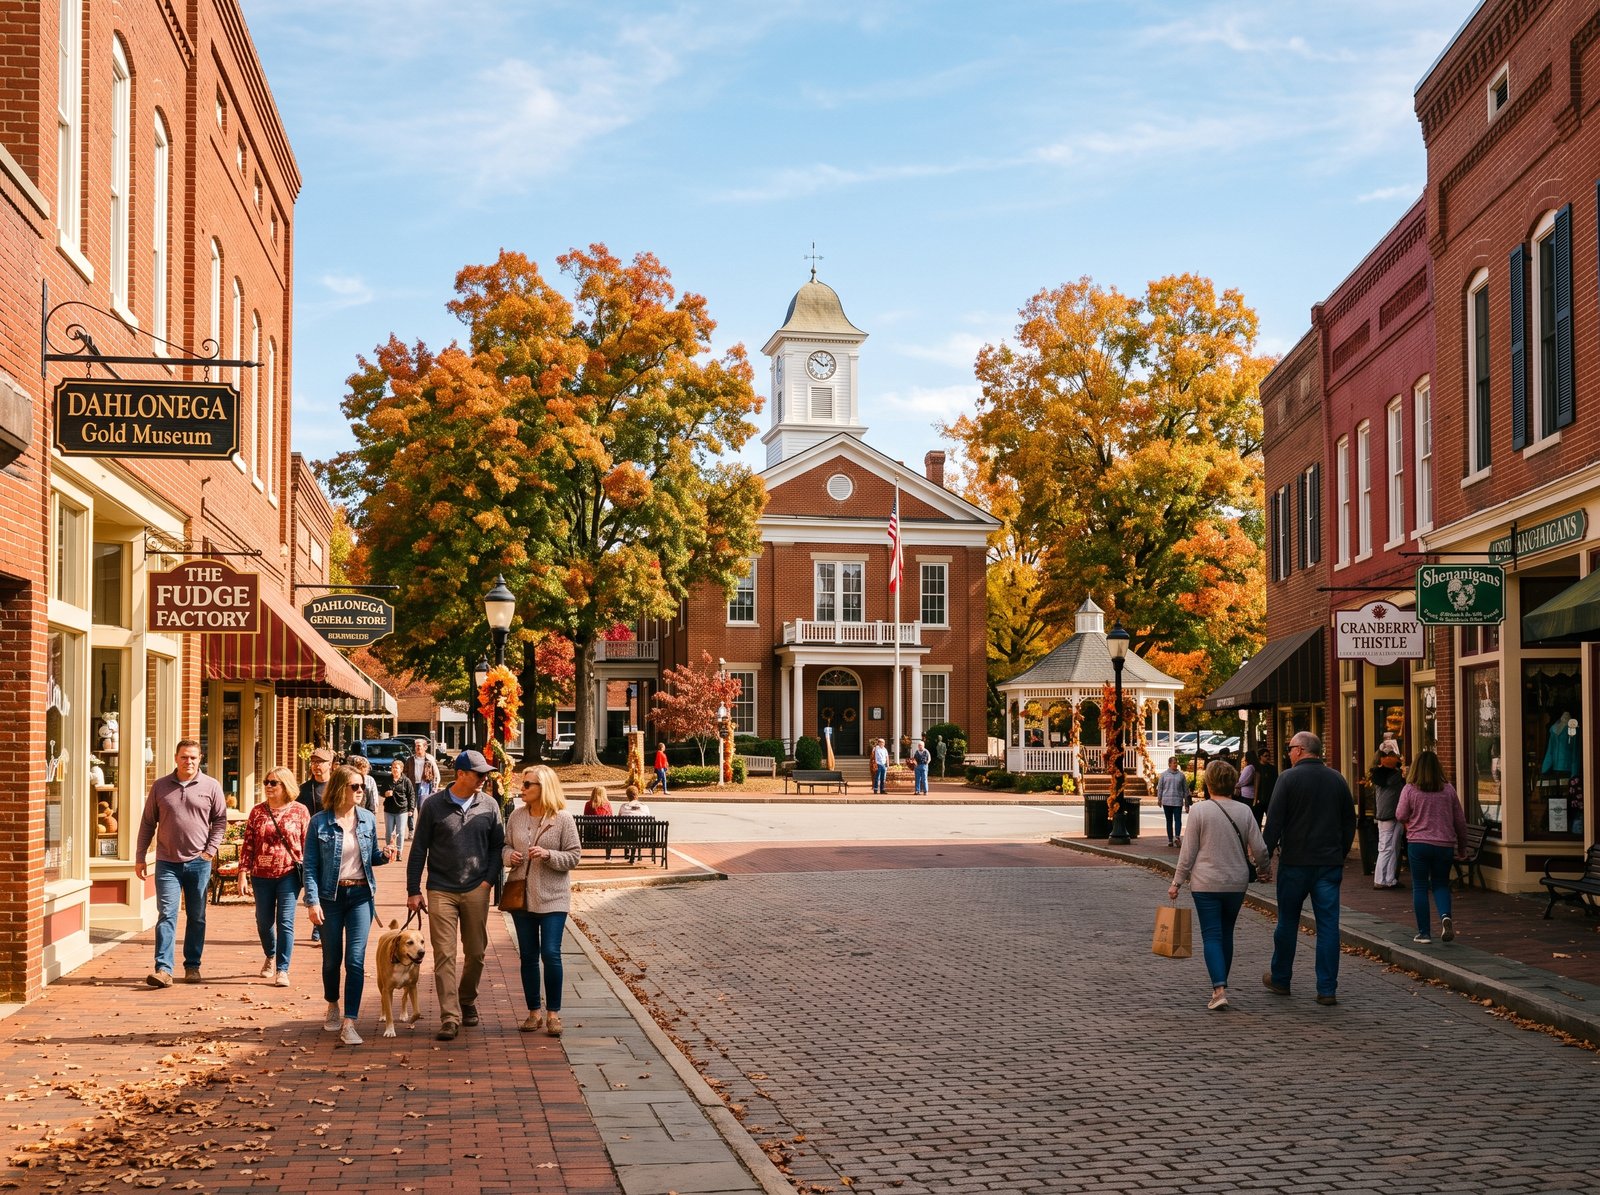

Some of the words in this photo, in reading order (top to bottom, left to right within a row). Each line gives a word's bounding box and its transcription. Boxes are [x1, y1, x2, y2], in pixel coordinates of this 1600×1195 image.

[67, 392, 227, 420] DAHLONEGA
[81, 422, 127, 443] Gold
[132, 423, 212, 445] Museum
[184, 567, 223, 582] THE
[1422, 568, 1500, 588] Shenanigans
[156, 585, 251, 607] FUDGE
[312, 600, 384, 614] DAHLONEGA
[156, 610, 250, 627] FACTORY
[310, 615, 354, 624] GENERAL
[356, 616, 387, 625] STORE
[1340, 622, 1419, 634] CRANBERRY
[1352, 637, 1408, 649] THISTLE
